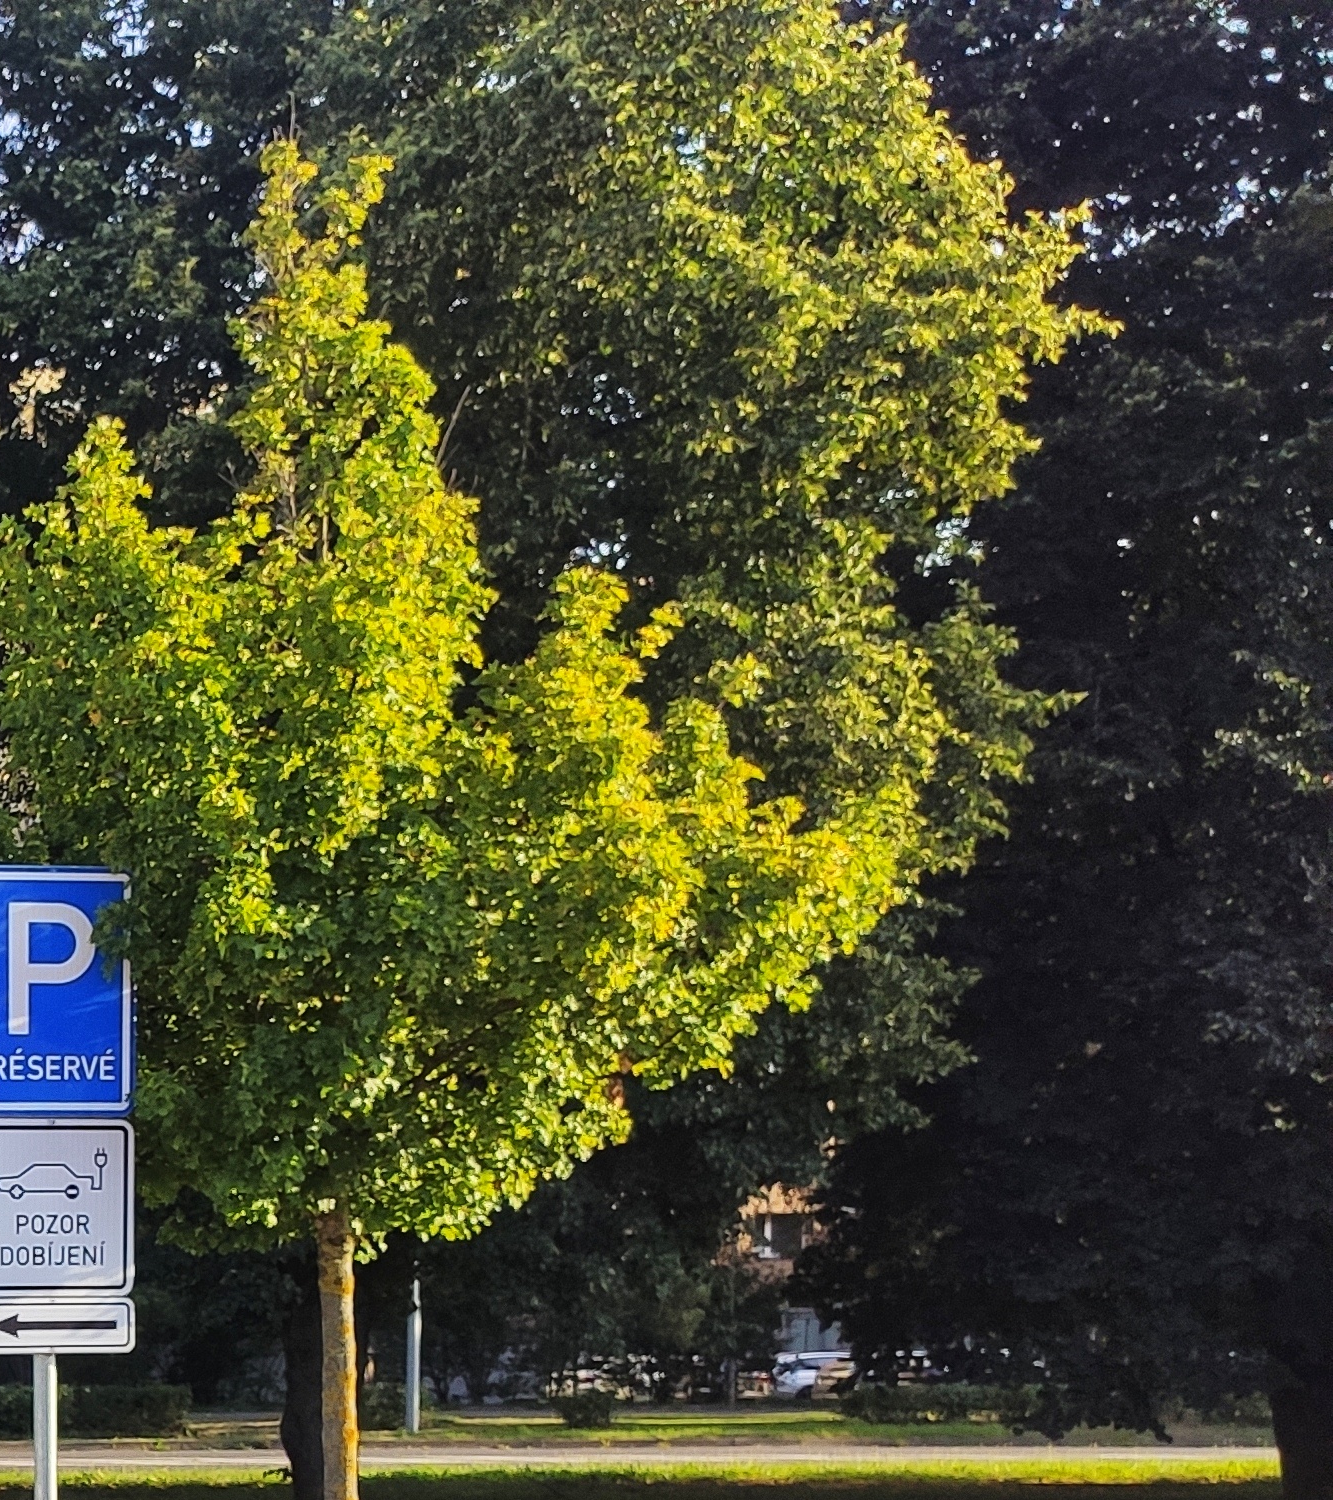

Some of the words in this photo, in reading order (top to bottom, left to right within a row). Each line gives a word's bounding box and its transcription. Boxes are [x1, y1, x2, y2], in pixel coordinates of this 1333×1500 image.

[8, 902, 96, 1035] P
[15, 1215, 90, 1235] POZOR
[0, 1241, 106, 1266] DOBÍJENÍ
